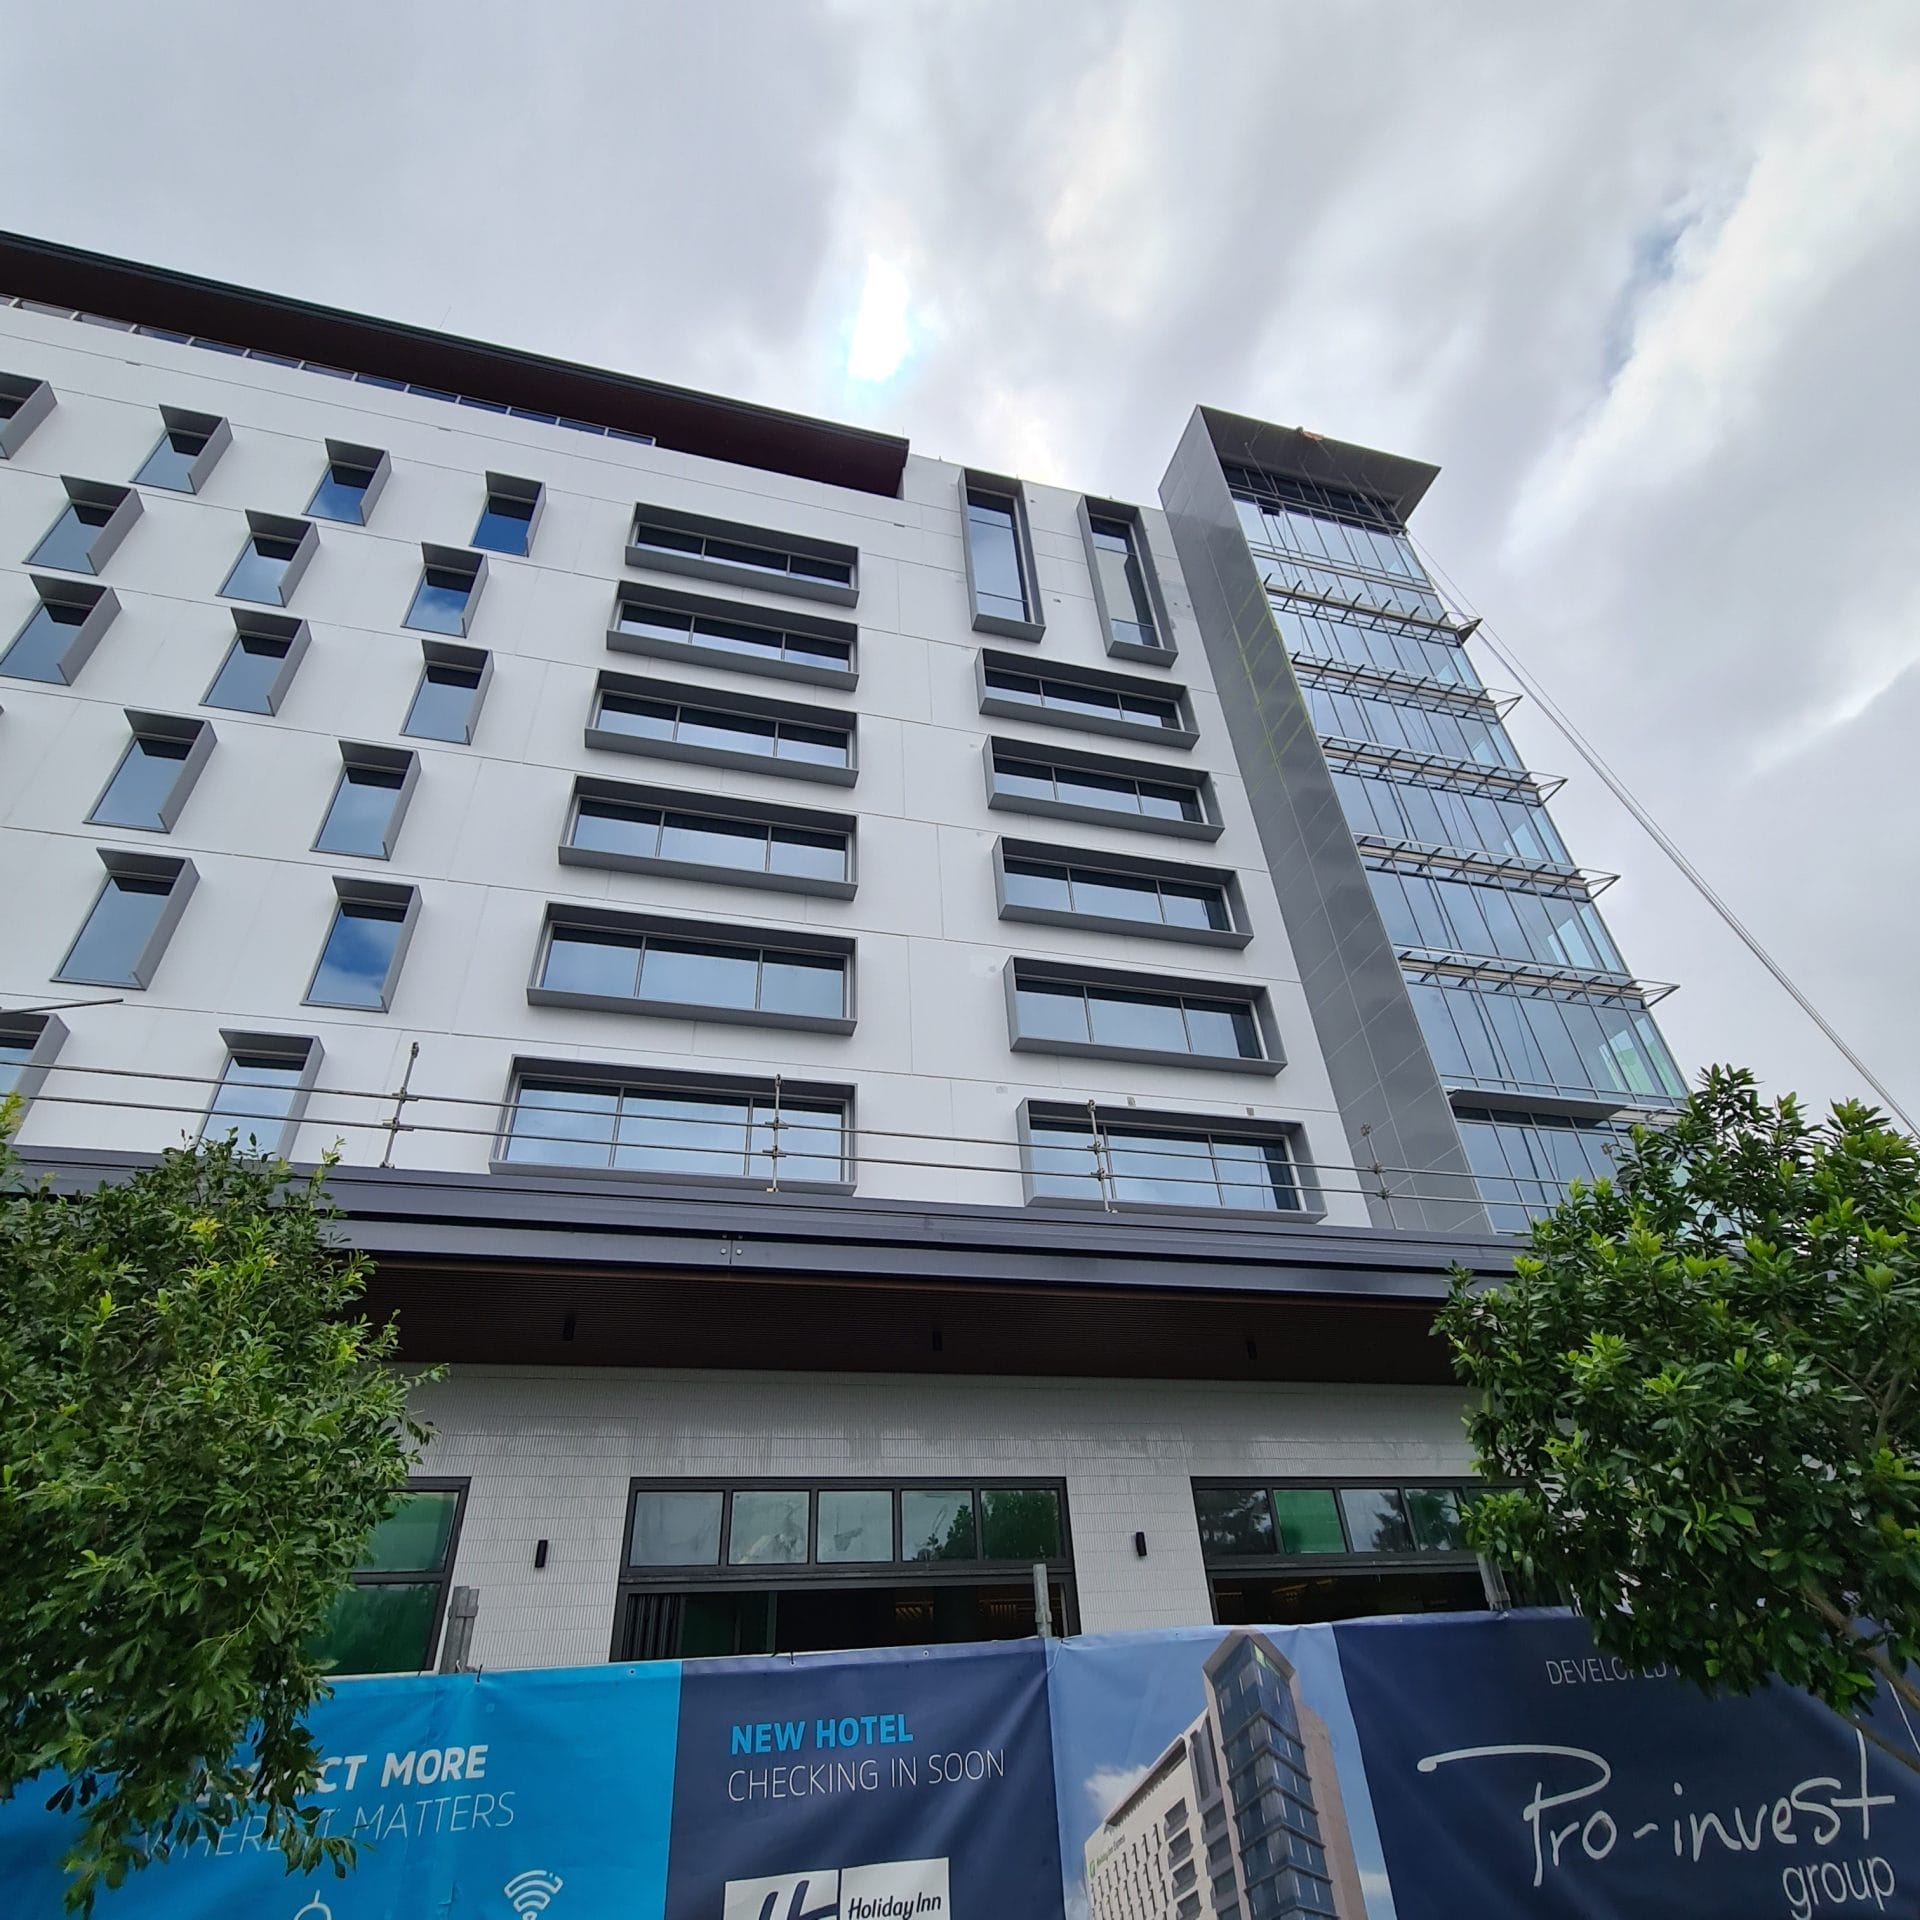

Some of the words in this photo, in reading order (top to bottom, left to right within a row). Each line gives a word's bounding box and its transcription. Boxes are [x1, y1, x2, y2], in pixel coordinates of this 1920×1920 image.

[731, 1721, 805, 1755] NEW
[816, 1714, 914, 1749] HOTEL
[380, 1744, 488, 1789] MORE
[727, 1759, 877, 1802] CHECKING
[891, 1757, 917, 1788] IN
[928, 1748, 1005, 1784] SOON
[352, 1791, 516, 1843] MATTERS
[1416, 1714, 1896, 1886] Pro-invest
[848, 1895, 914, 1920] Holiday
[916, 1892, 942, 1913] Inn
[1782, 1856, 1895, 1920] group
